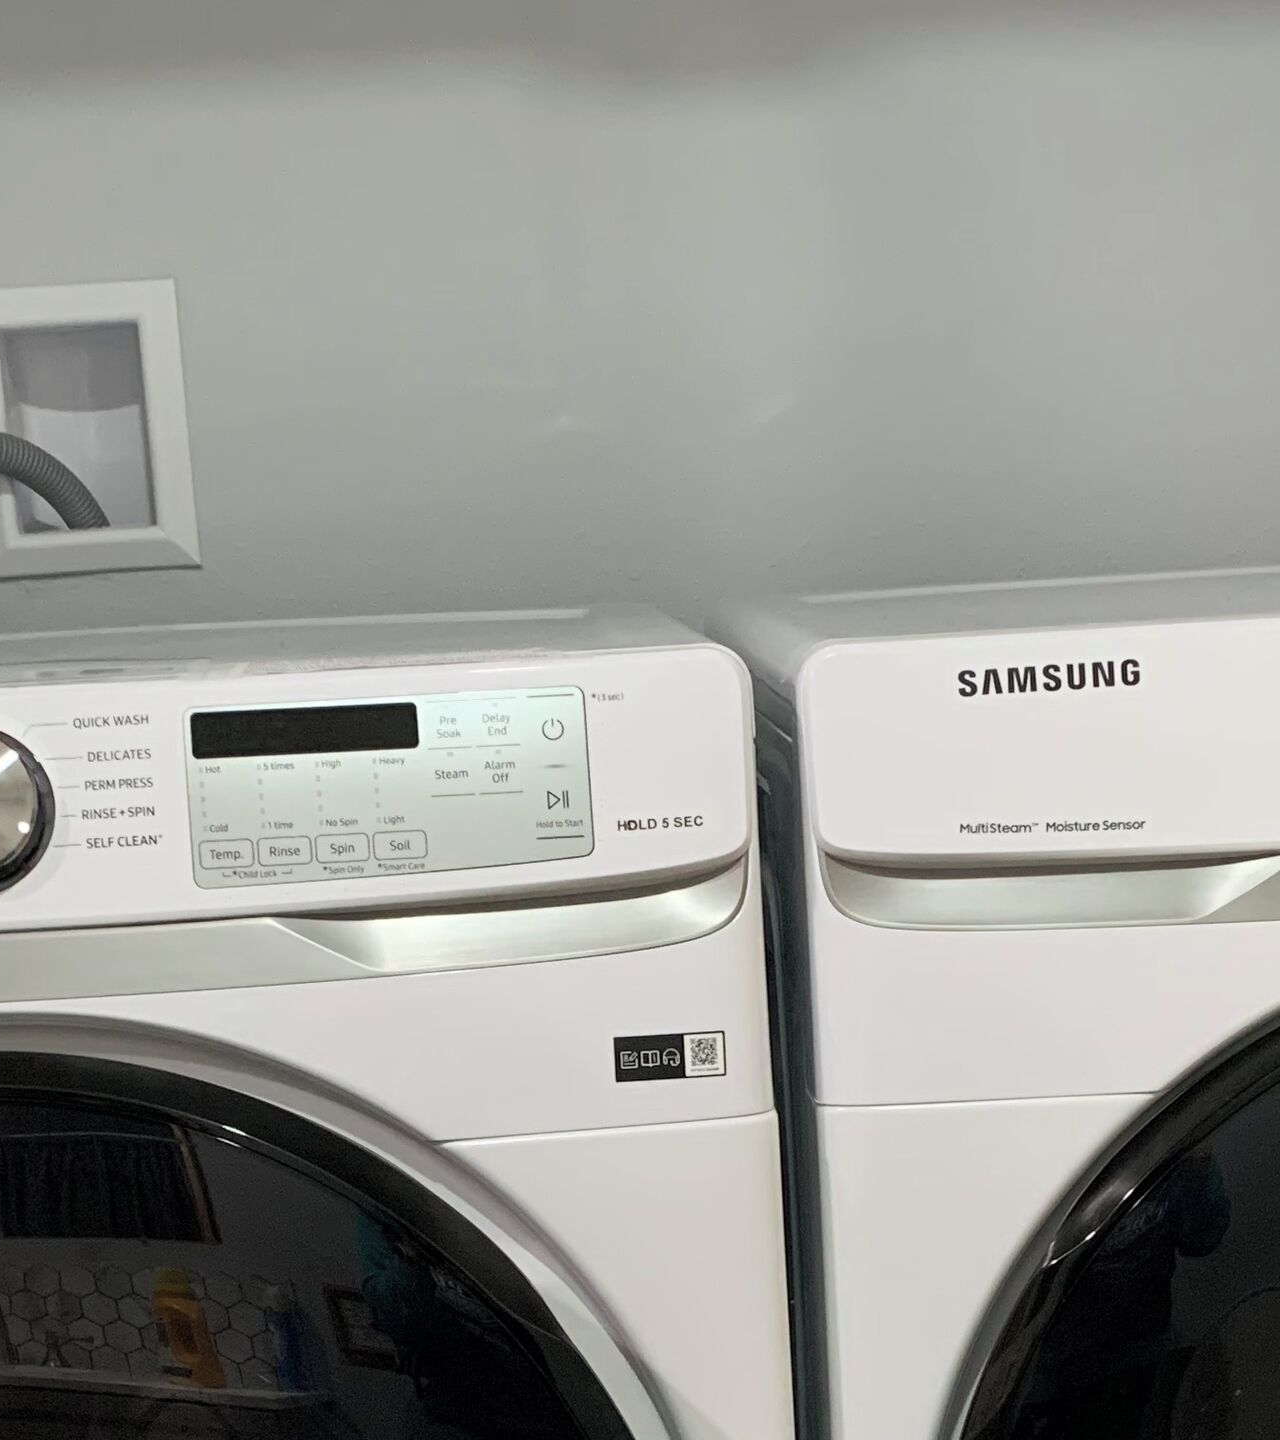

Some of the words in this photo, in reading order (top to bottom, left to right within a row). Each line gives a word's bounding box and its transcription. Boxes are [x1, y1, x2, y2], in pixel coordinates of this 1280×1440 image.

[957, 658, 1141, 698] SAMSUNG
[72, 716, 111, 730] QUICK
[113, 714, 149, 727] WASH
[439, 715, 457, 725] Pre
[481, 712, 511, 724] Delay
[436, 728, 461, 739] Soak
[487, 725, 507, 736] End
[87, 748, 152, 762] DELICATES
[270, 761, 295, 771] times
[321, 759, 341, 769] High
[378, 756, 405, 767] Heavy
[484, 760, 516, 771] Alarm
[205, 765, 221, 774] Hot
[434, 768, 469, 781] Steam
[492, 772, 510, 783] Off
[84, 780, 116, 791] PERM
[118, 777, 154, 790] PRESS
[81, 807, 117, 820] RINSE
[127, 806, 155, 818] SPIN
[273, 820, 294, 830] time
[325, 818, 338, 827] No
[339, 816, 359, 828] Spin
[383, 814, 406, 826] Light
[536, 820, 555, 829] Hold
[564, 819, 583, 828] Start
[617, 817, 658, 832] HOLD
[662, 817, 670, 829] 5
[673, 815, 704, 828] SEC
[1046, 819, 1101, 833] Moisture
[1102, 818, 1147, 831] Sensor
[209, 823, 229, 833] Cold
[86, 837, 114, 849] SELF
[330, 842, 355, 856] Spin
[389, 839, 411, 852] Soil
[269, 845, 301, 857] Rinse
